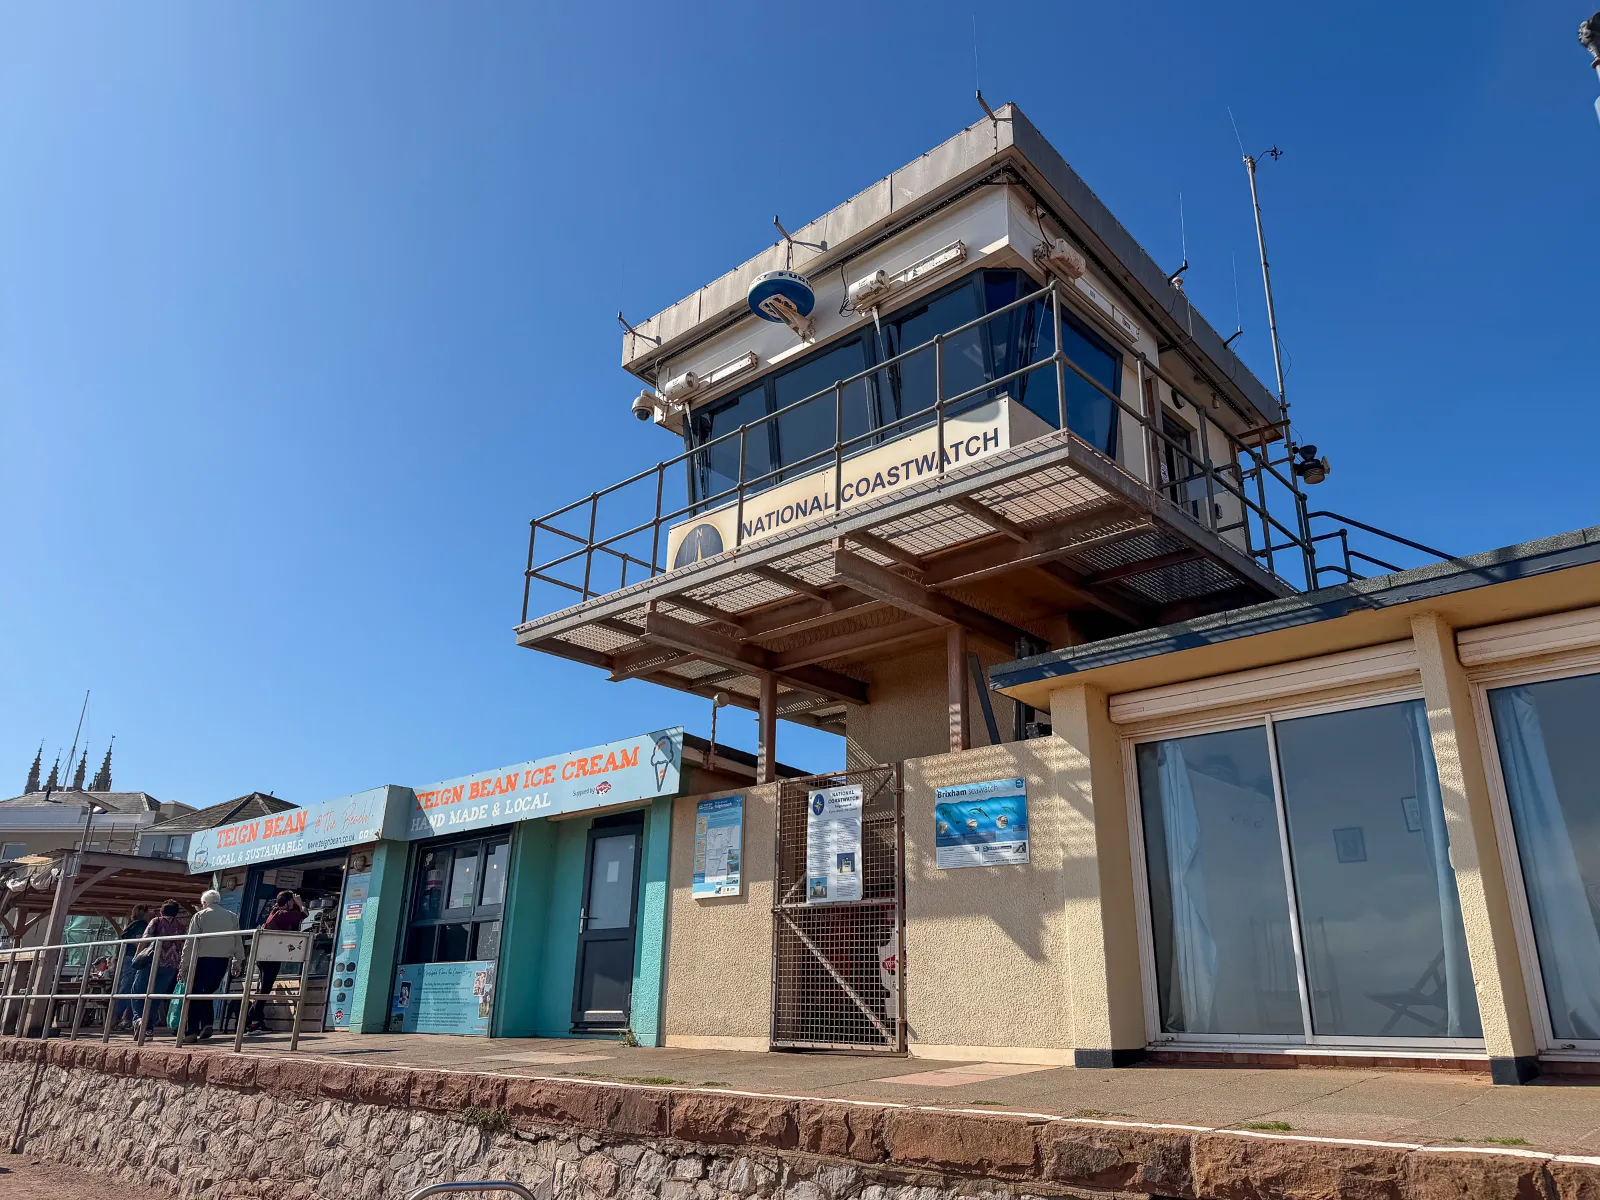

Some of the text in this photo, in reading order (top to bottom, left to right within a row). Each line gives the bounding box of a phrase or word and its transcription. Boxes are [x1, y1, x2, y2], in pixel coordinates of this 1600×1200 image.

[742, 427, 999, 540] NATIONAL COASTWATCH
[415, 746, 640, 811] TEIGN BEAN ICE CREAM
[832, 789, 855, 797] NATIONAL
[937, 784, 999, 799] Brixham seawatch
[410, 792, 551, 833] HAND MADE & LOCAL
[828, 795, 860, 804] COASTWATCH
[217, 809, 309, 849] TEIGN BEAN
[211, 838, 305, 867] LOCAL & SUSTAINABLE
